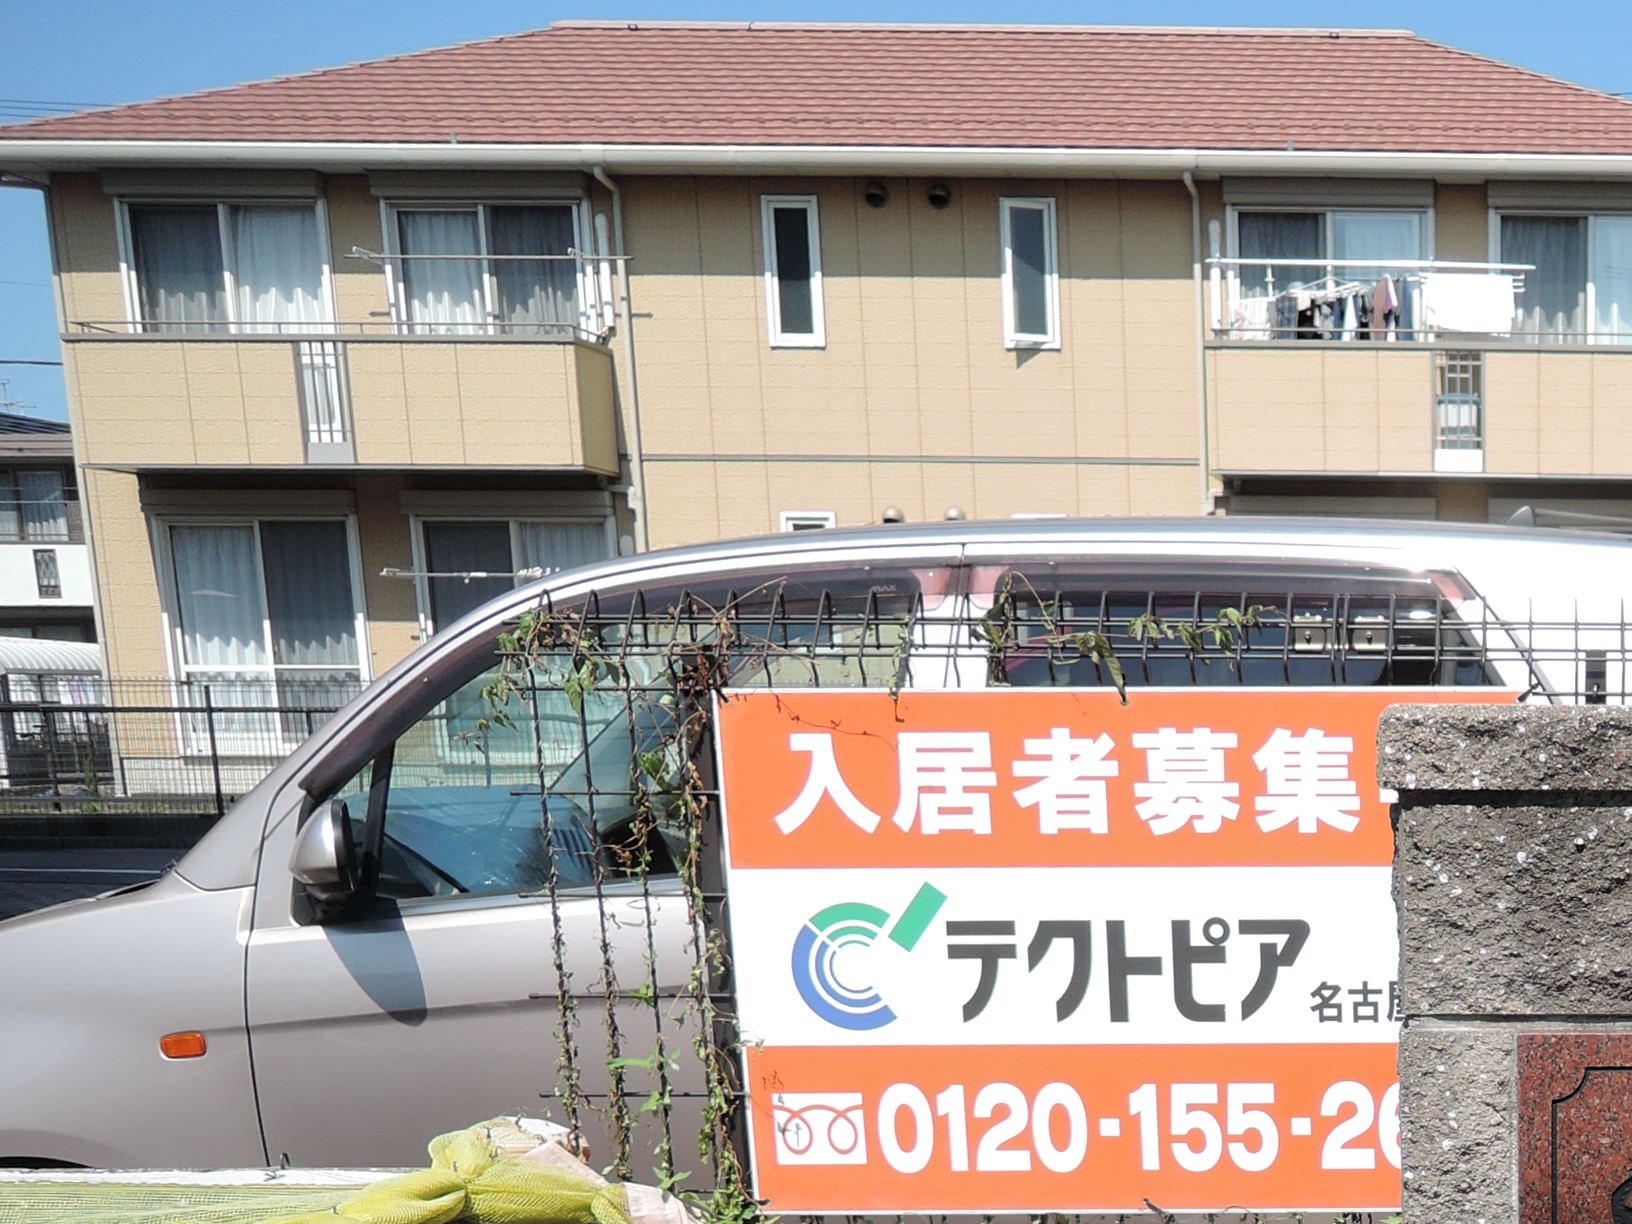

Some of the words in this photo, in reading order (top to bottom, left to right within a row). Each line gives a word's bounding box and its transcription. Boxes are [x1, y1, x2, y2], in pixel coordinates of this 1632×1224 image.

[774, 726, 1398, 836] 入居者募集
[945, 917, 1311, 1023] テクトピア
